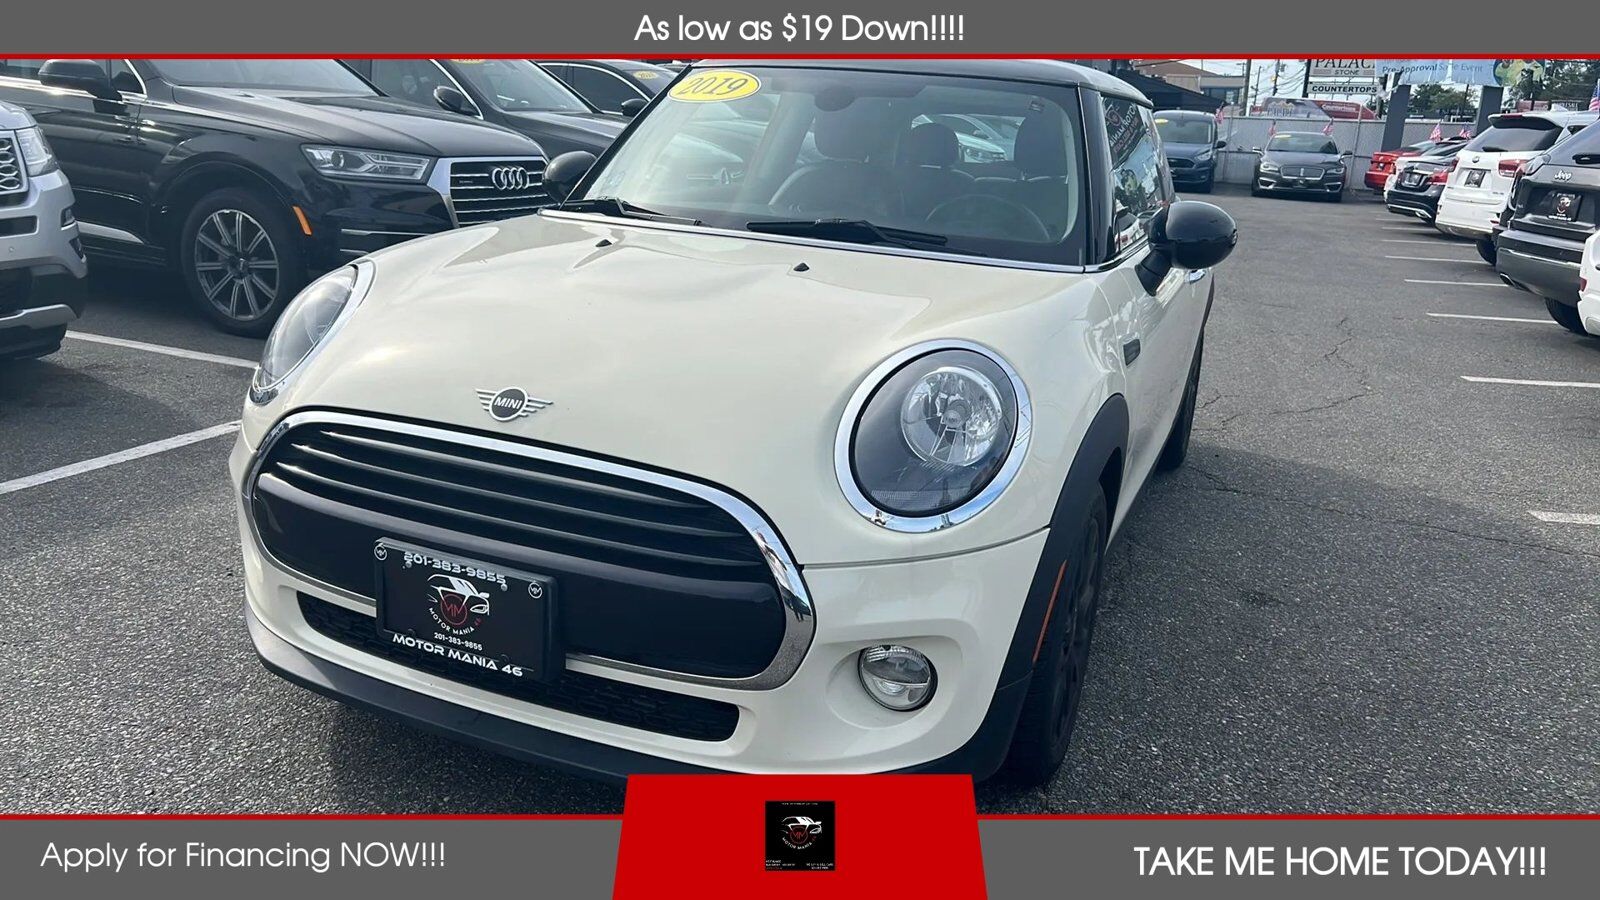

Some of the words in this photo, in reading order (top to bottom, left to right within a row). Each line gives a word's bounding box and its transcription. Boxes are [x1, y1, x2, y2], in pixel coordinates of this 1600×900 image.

[1382, 64, 1438, 73] Pre-Approval
[676, 76, 749, 96] 2019
[1311, 85, 1378, 93] COUNTERTOPS
[1554, 170, 1572, 181] Jeep
[494, 396, 523, 410] MINI
[403, 551, 507, 584] 201-383-9855
[429, 607, 451, 632] MOTOR
[452, 626, 475, 636] MANIA
[433, 632, 483, 651] 201-383-9855
[392, 633, 445, 656] MOTOR
[447, 649, 499, 671] MANIA
[501, 664, 524, 677] 46
